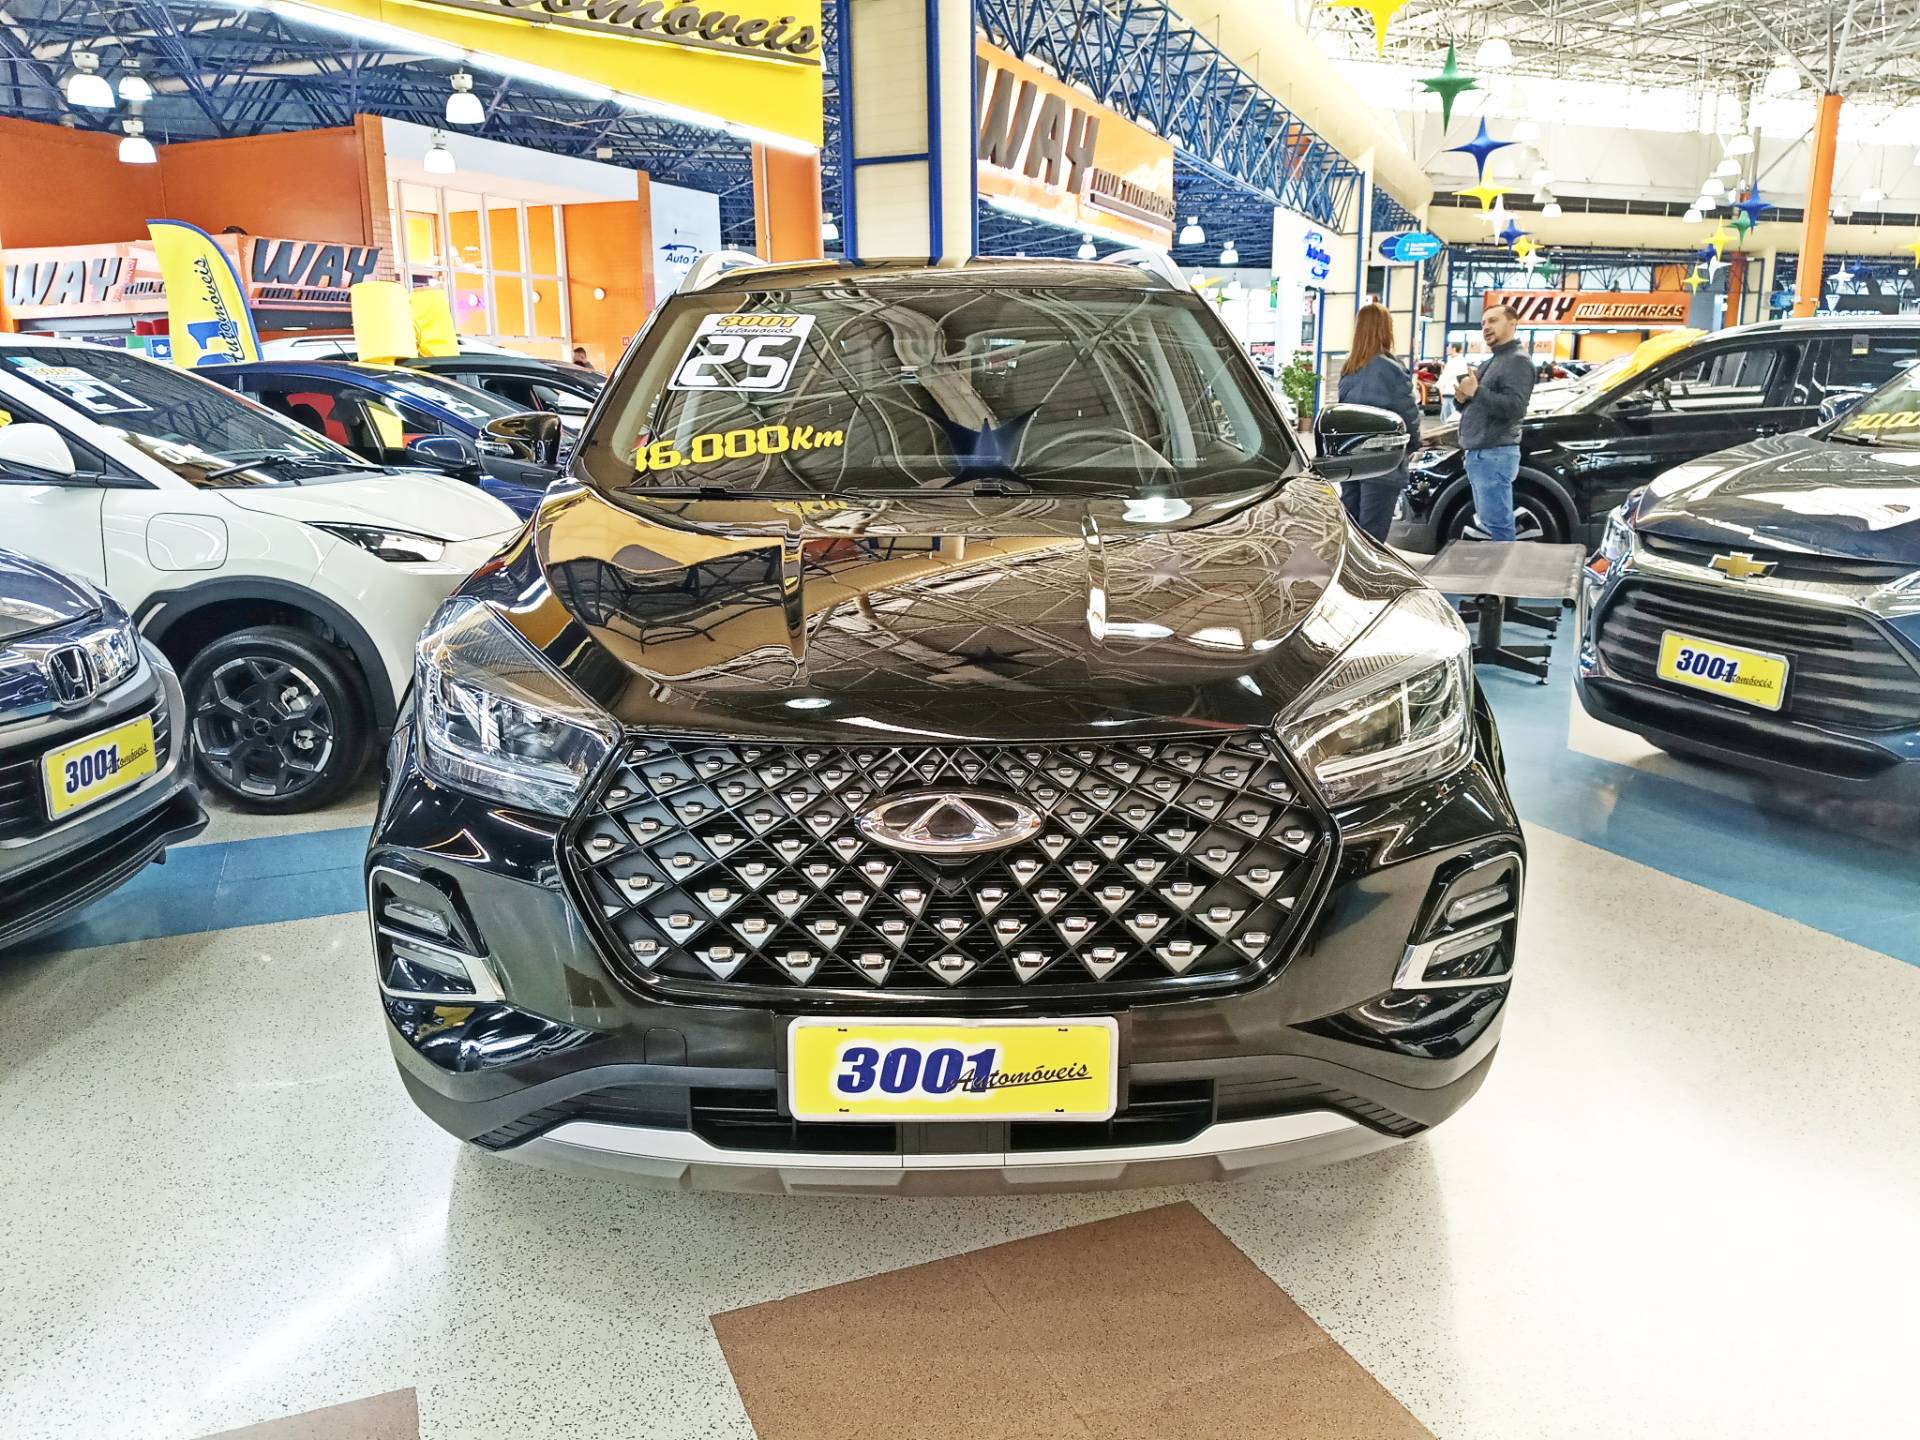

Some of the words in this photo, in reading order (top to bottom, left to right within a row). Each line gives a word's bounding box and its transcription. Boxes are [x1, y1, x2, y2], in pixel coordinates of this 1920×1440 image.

[977, 55, 1100, 194] WAY
[5, 257, 122, 305] WAY
[252, 238, 381, 287] WAY
[665, 252, 690, 264] Auto
[717, 315, 799, 328] 3001
[1500, 296, 1576, 321] WAY
[678, 335, 793, 388] 25
[1676, 649, 1738, 683] 3001
[65, 744, 117, 793] 3001
[837, 1046, 996, 1093] 3001
[945, 1061, 1092, 1093] Automóveis
